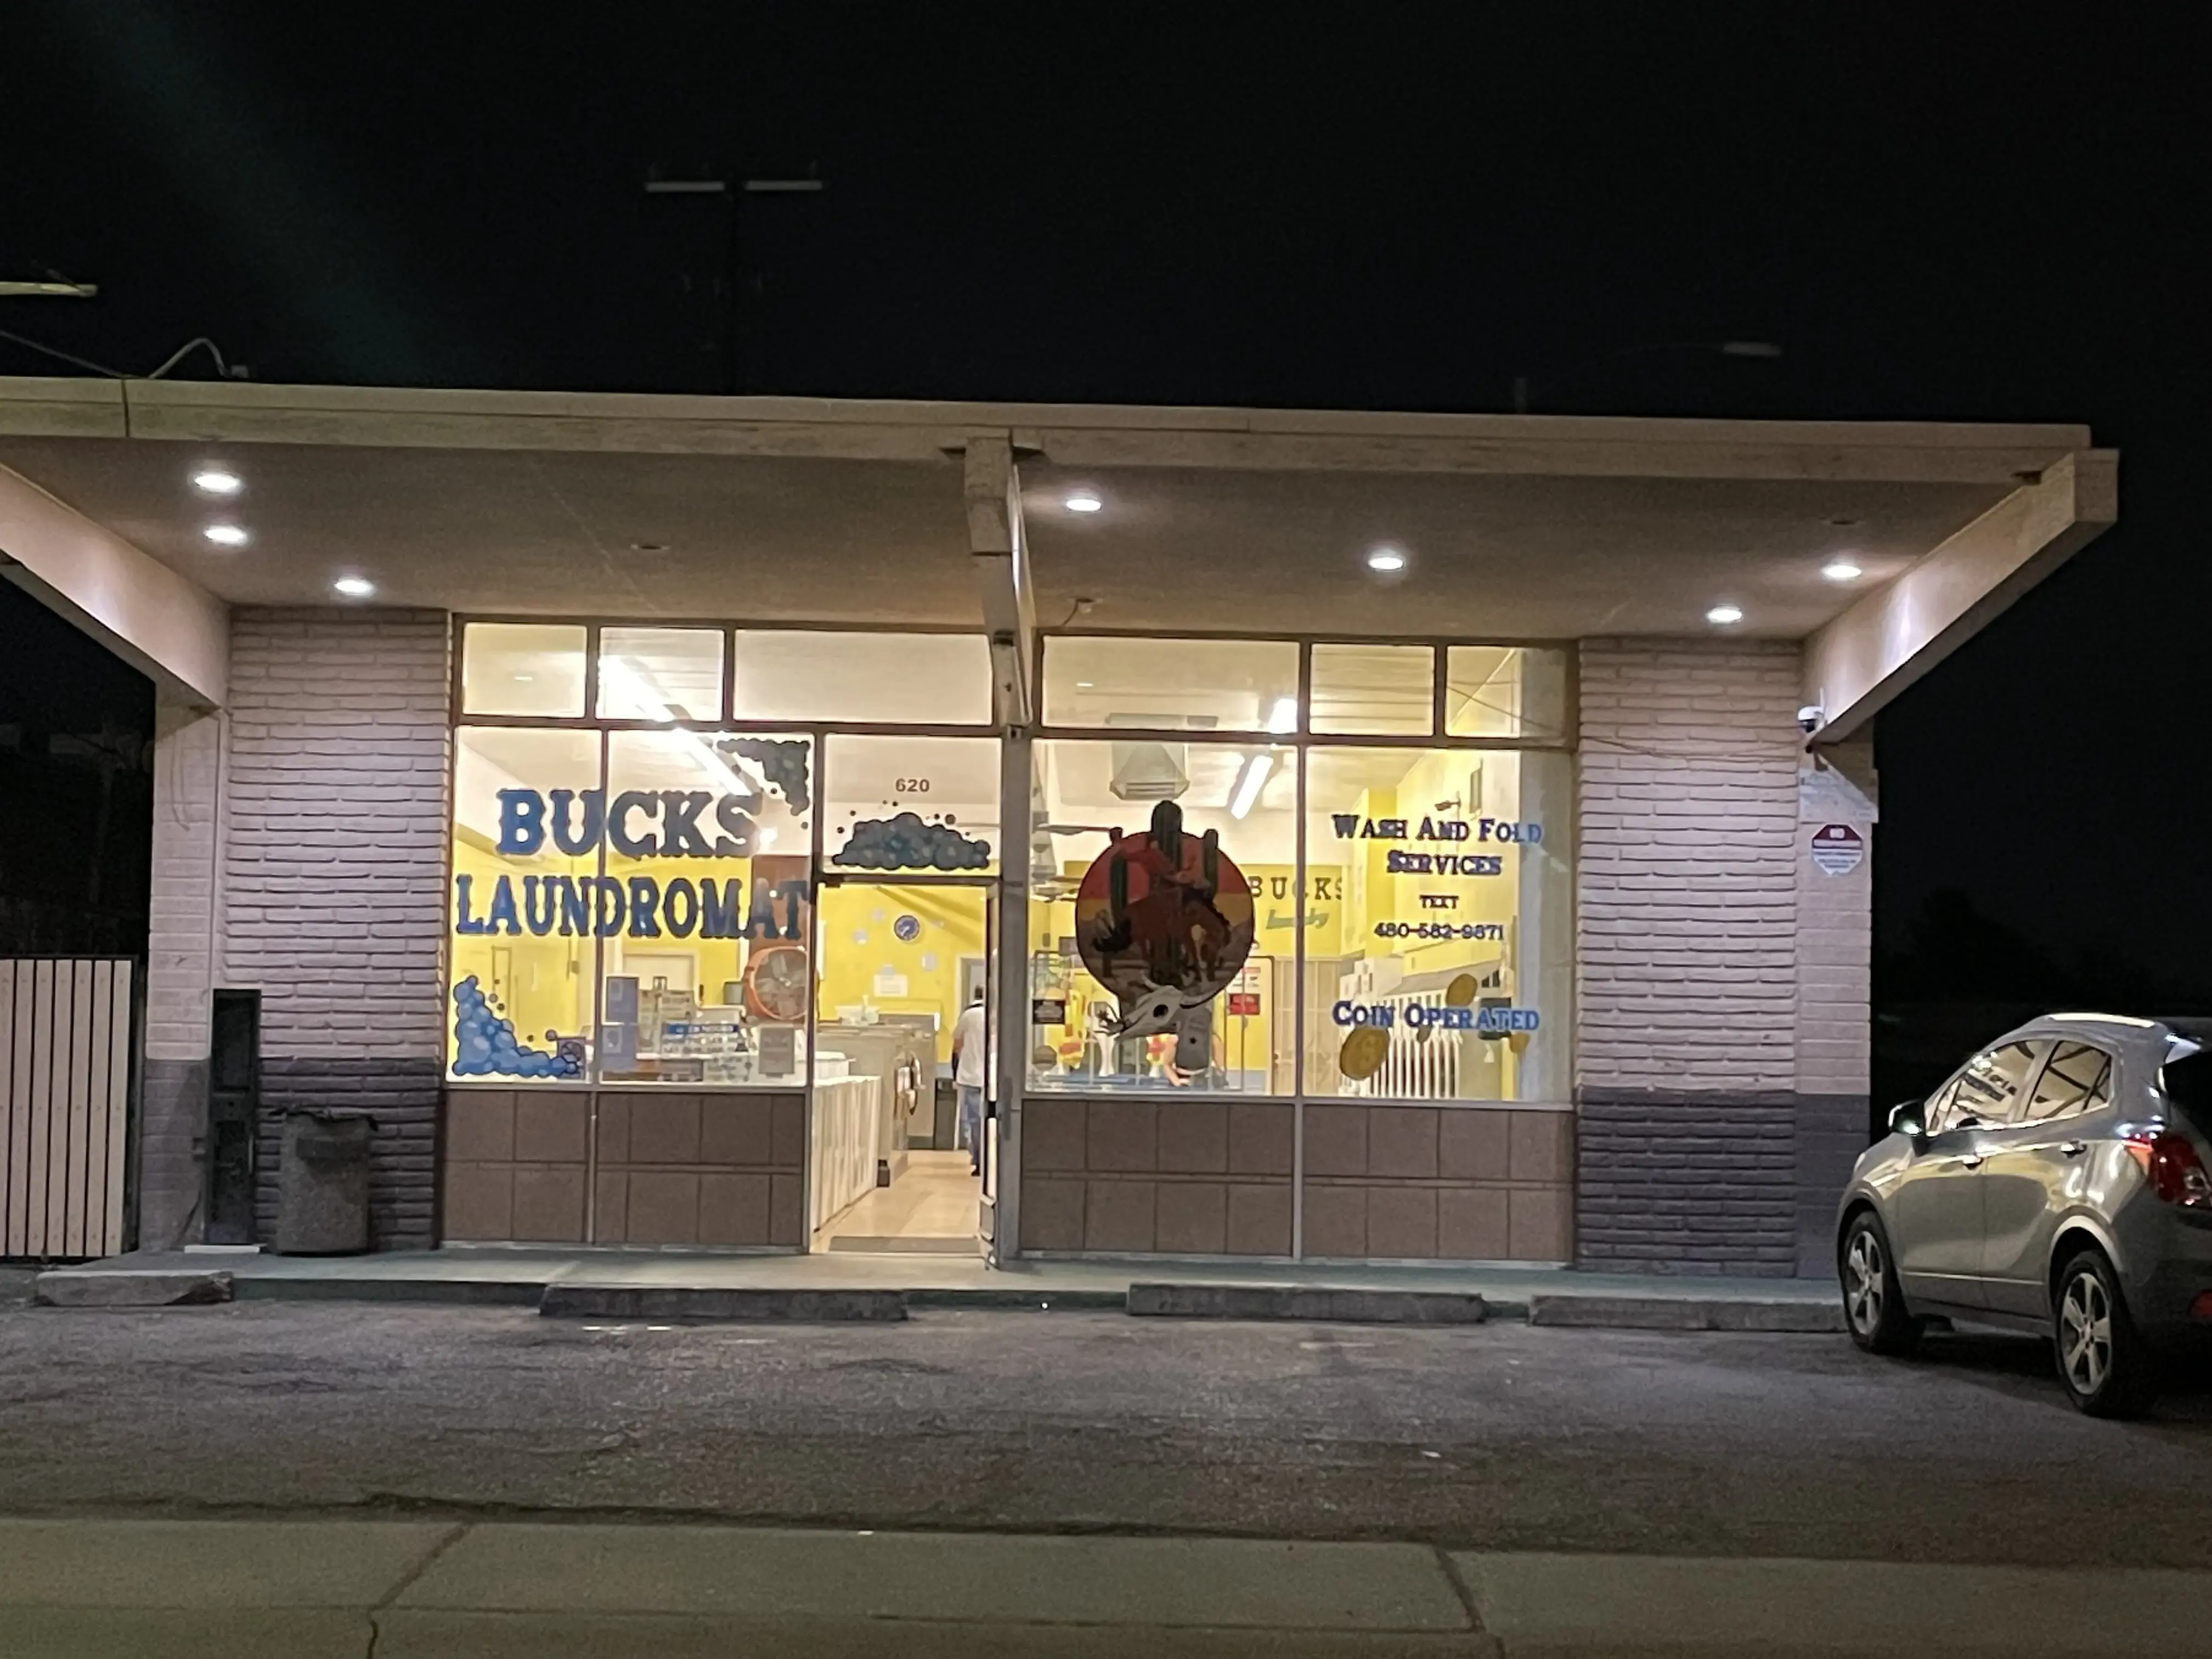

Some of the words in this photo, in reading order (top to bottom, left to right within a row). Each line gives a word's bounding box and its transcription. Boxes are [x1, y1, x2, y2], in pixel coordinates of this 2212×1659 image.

[895, 778, 930, 792] 620
[496, 788, 763, 859] BUCKS
[1332, 814, 1408, 839] WASH
[1416, 816, 1470, 841] AND
[1478, 818, 1542, 844] FOLD
[1387, 849, 1502, 875] SERVICES
[456, 874, 808, 939] LAUNDROMAT
[1419, 895, 1459, 909] TEXT
[1333, 1001, 1396, 1028] COIN
[1404, 1003, 1540, 1030] OPERATED
